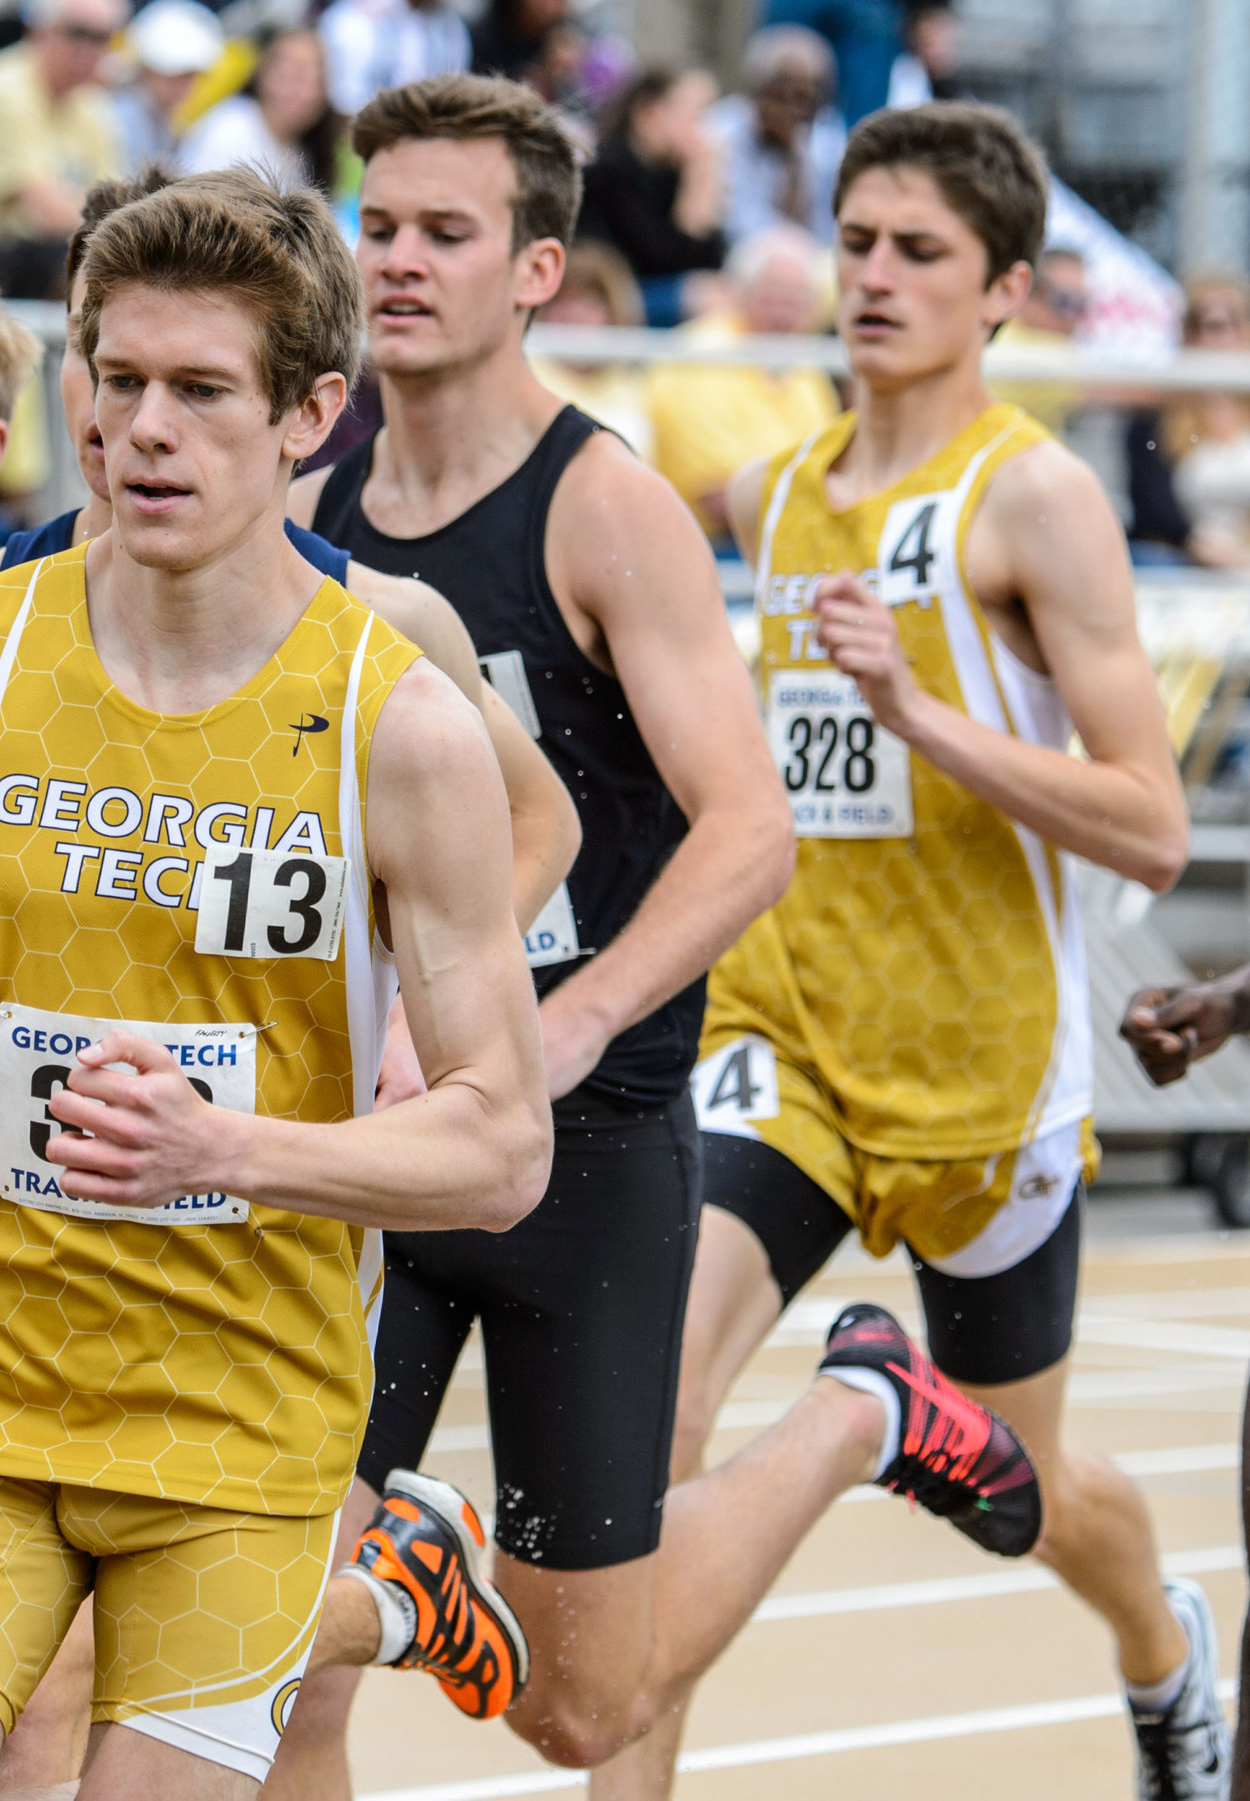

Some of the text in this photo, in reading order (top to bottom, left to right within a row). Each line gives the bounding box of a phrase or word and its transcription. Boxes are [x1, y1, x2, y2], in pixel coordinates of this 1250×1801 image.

[890, 502, 936, 585] 4
[785, 717, 874, 792] 328
[213, 852, 327, 954] 13
[707, 1047, 761, 1109] 4
